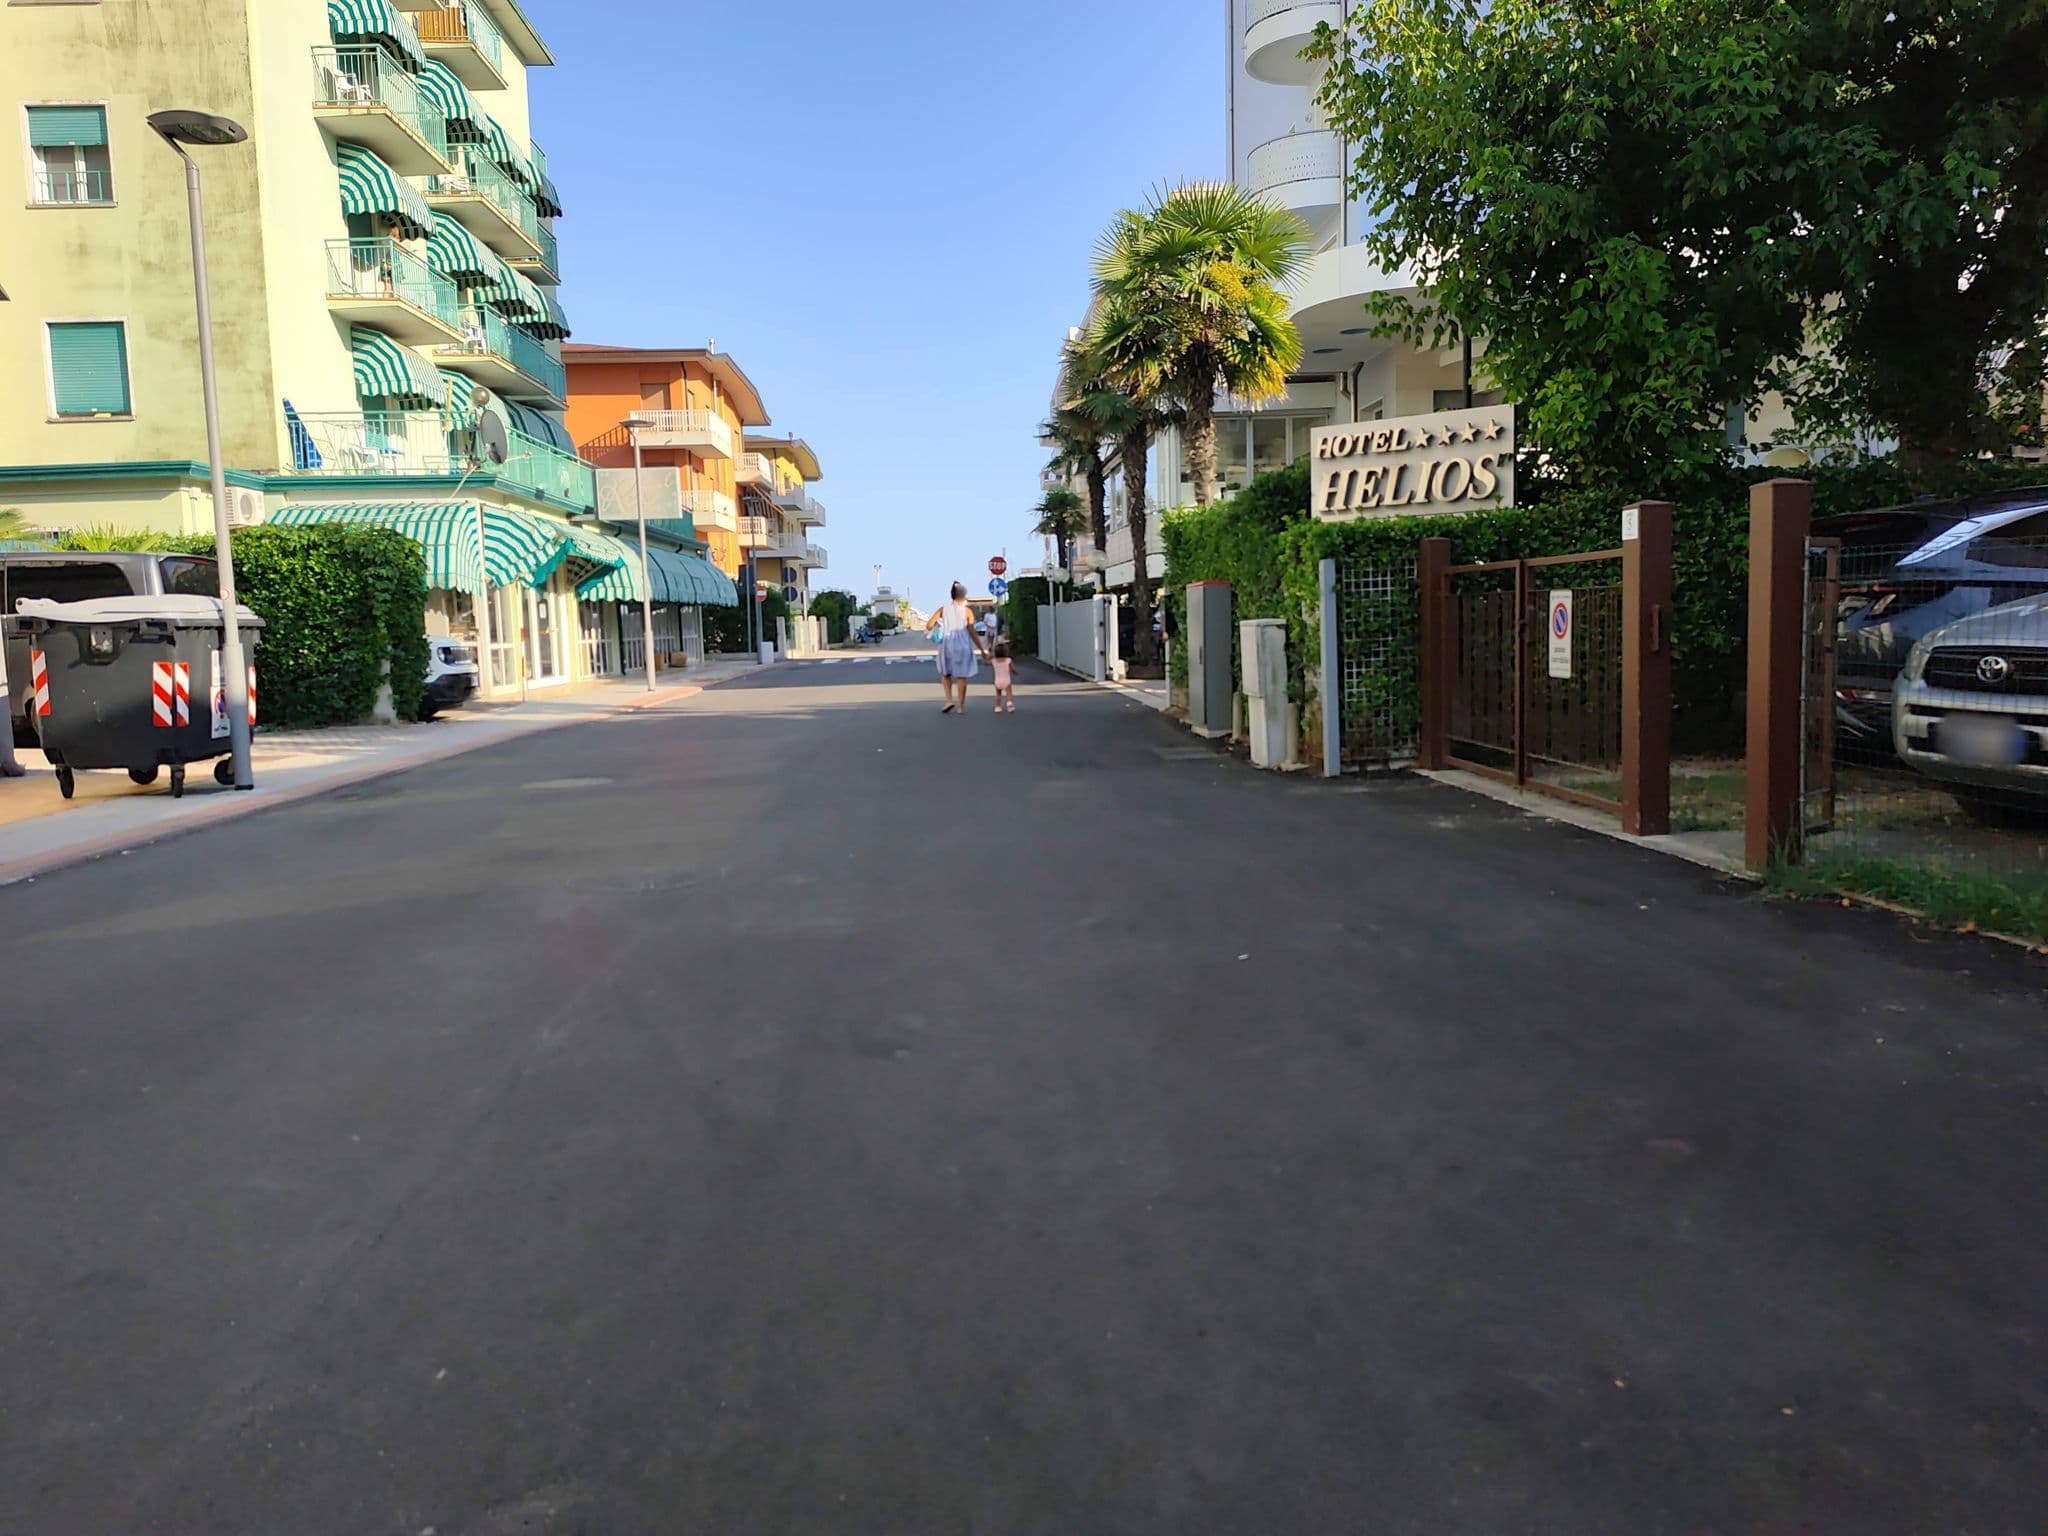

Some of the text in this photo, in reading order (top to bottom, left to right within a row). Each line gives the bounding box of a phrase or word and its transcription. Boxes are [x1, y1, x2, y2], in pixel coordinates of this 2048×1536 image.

[1316, 427, 1410, 459] HOTEL
[1319, 453, 1498, 512] HELIOS
[989, 561, 1006, 570] STOP
